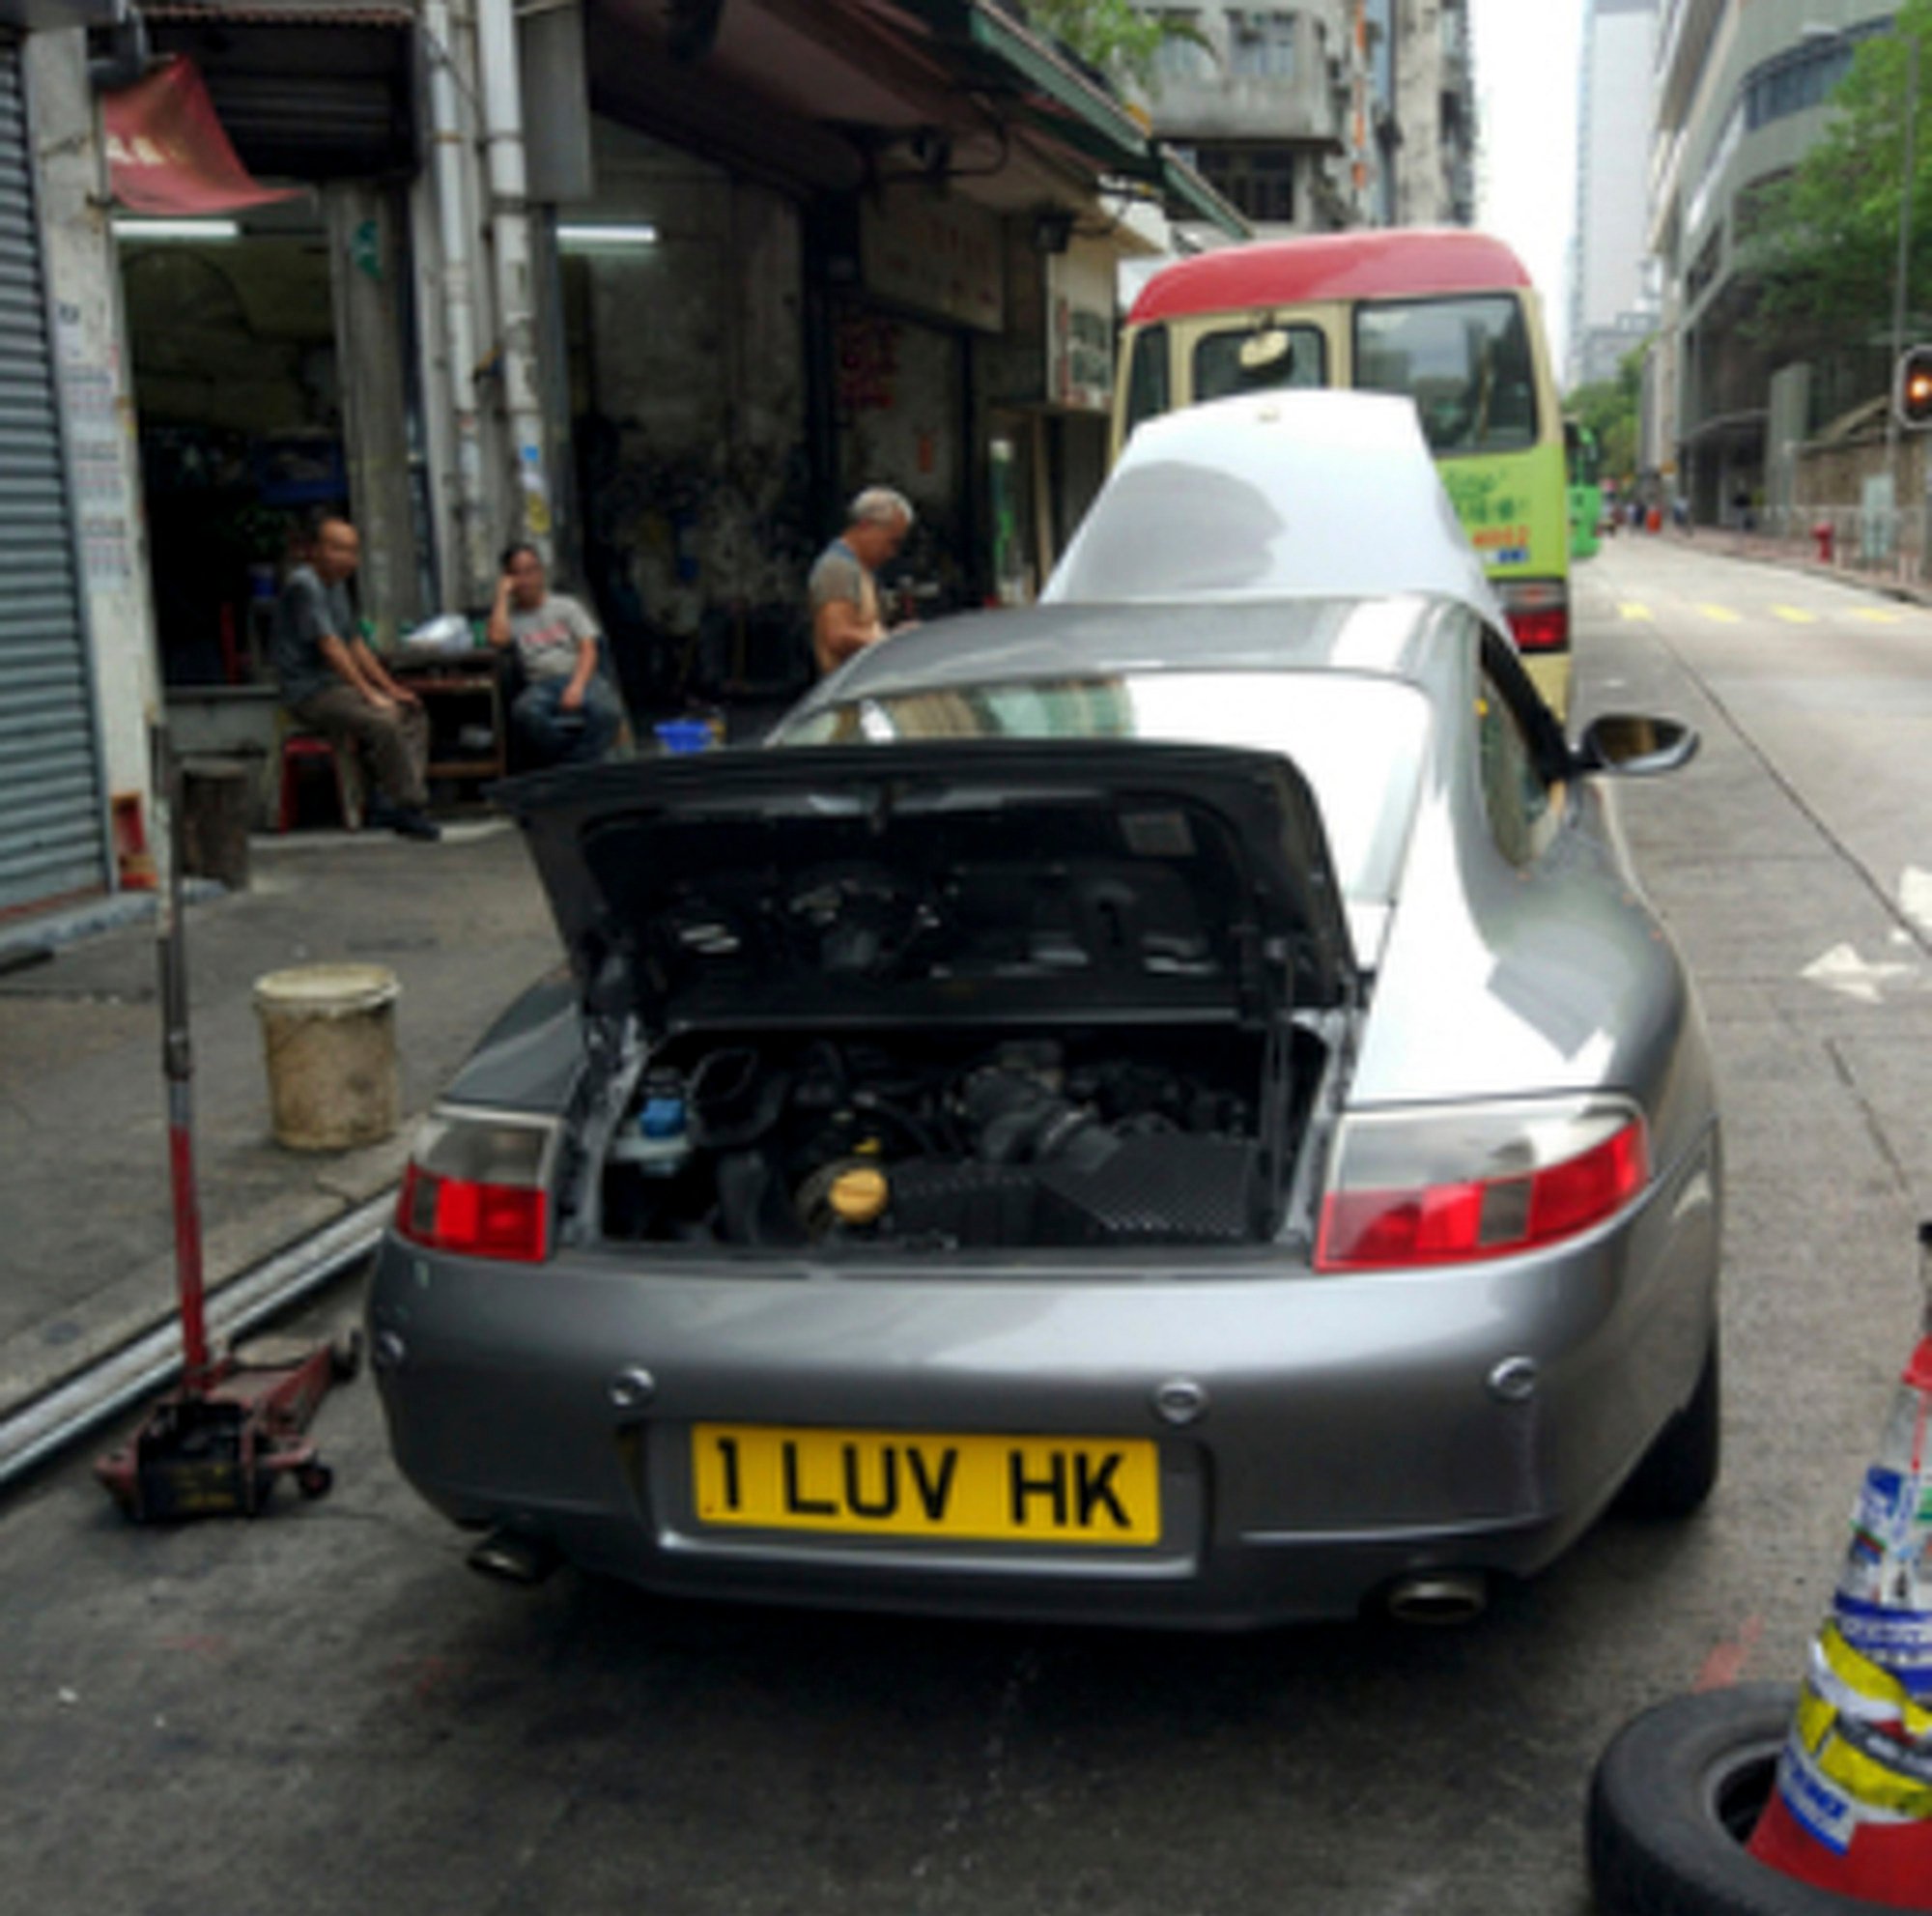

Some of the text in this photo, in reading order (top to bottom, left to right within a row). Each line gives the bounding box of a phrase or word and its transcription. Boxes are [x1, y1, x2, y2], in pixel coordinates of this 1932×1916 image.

[717, 1436, 1132, 1529] 1 LUV HK
